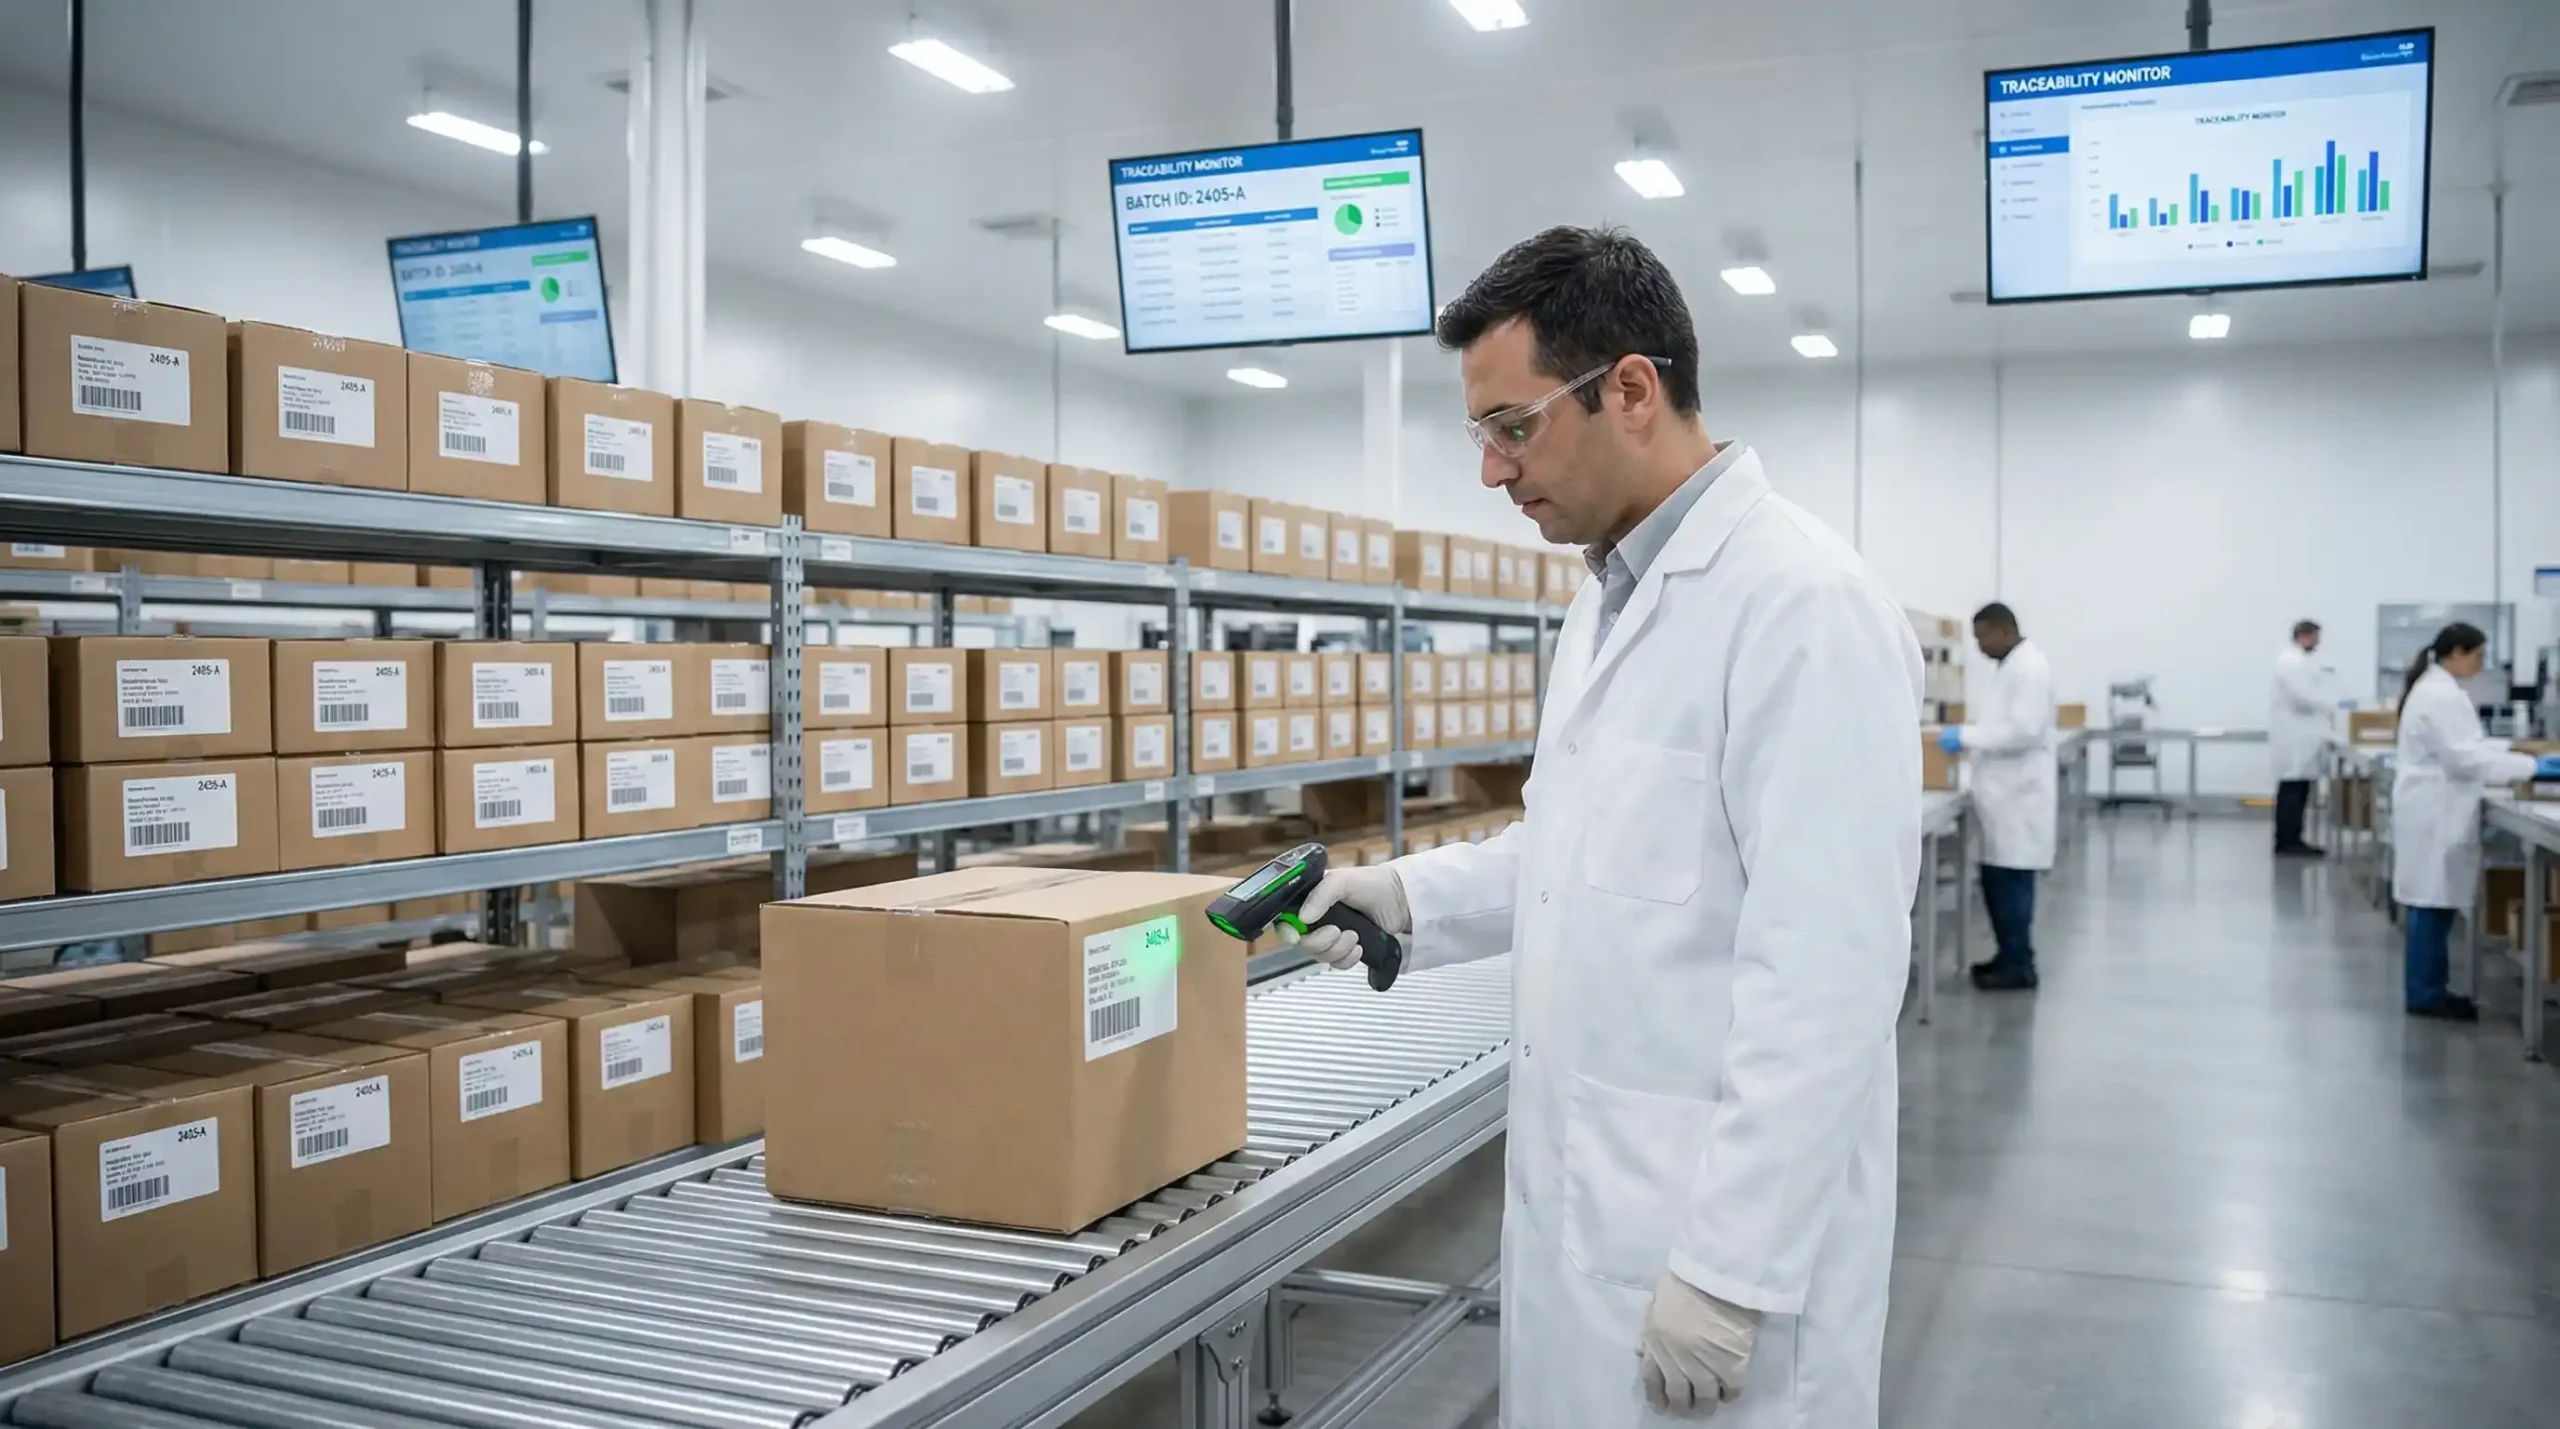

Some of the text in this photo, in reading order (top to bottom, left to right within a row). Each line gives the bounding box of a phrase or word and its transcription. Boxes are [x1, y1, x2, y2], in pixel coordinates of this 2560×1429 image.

[2000, 65, 2172, 95] TRACEABILITY MONITOR
[2195, 112, 2251, 125] TRACEABILITY
[1120, 155, 1244, 179] TRACEABILITY MONITOR
[1125, 185, 1247, 210] BATCH ID: 2405-A
[149, 352, 180, 367] 2405-A
